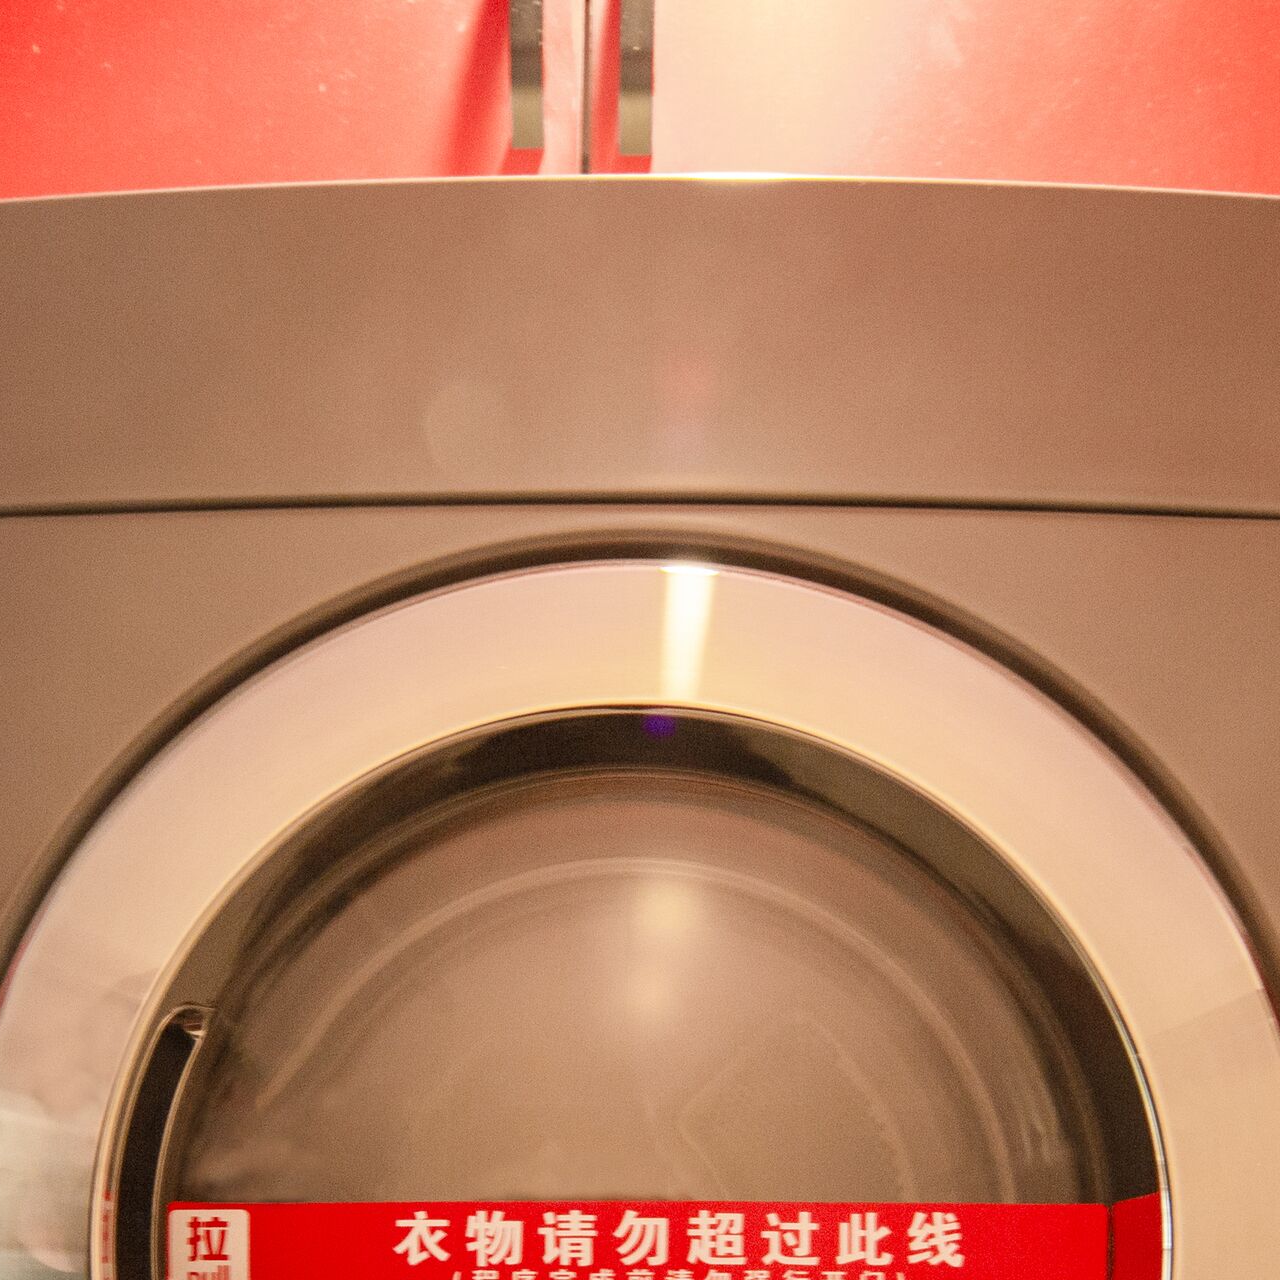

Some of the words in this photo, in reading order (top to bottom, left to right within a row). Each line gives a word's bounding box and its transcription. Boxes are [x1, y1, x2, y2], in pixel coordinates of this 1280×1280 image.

[186, 1216, 229, 1261] 拉
[393, 1210, 966, 1267] 衣物请勿超过此线
